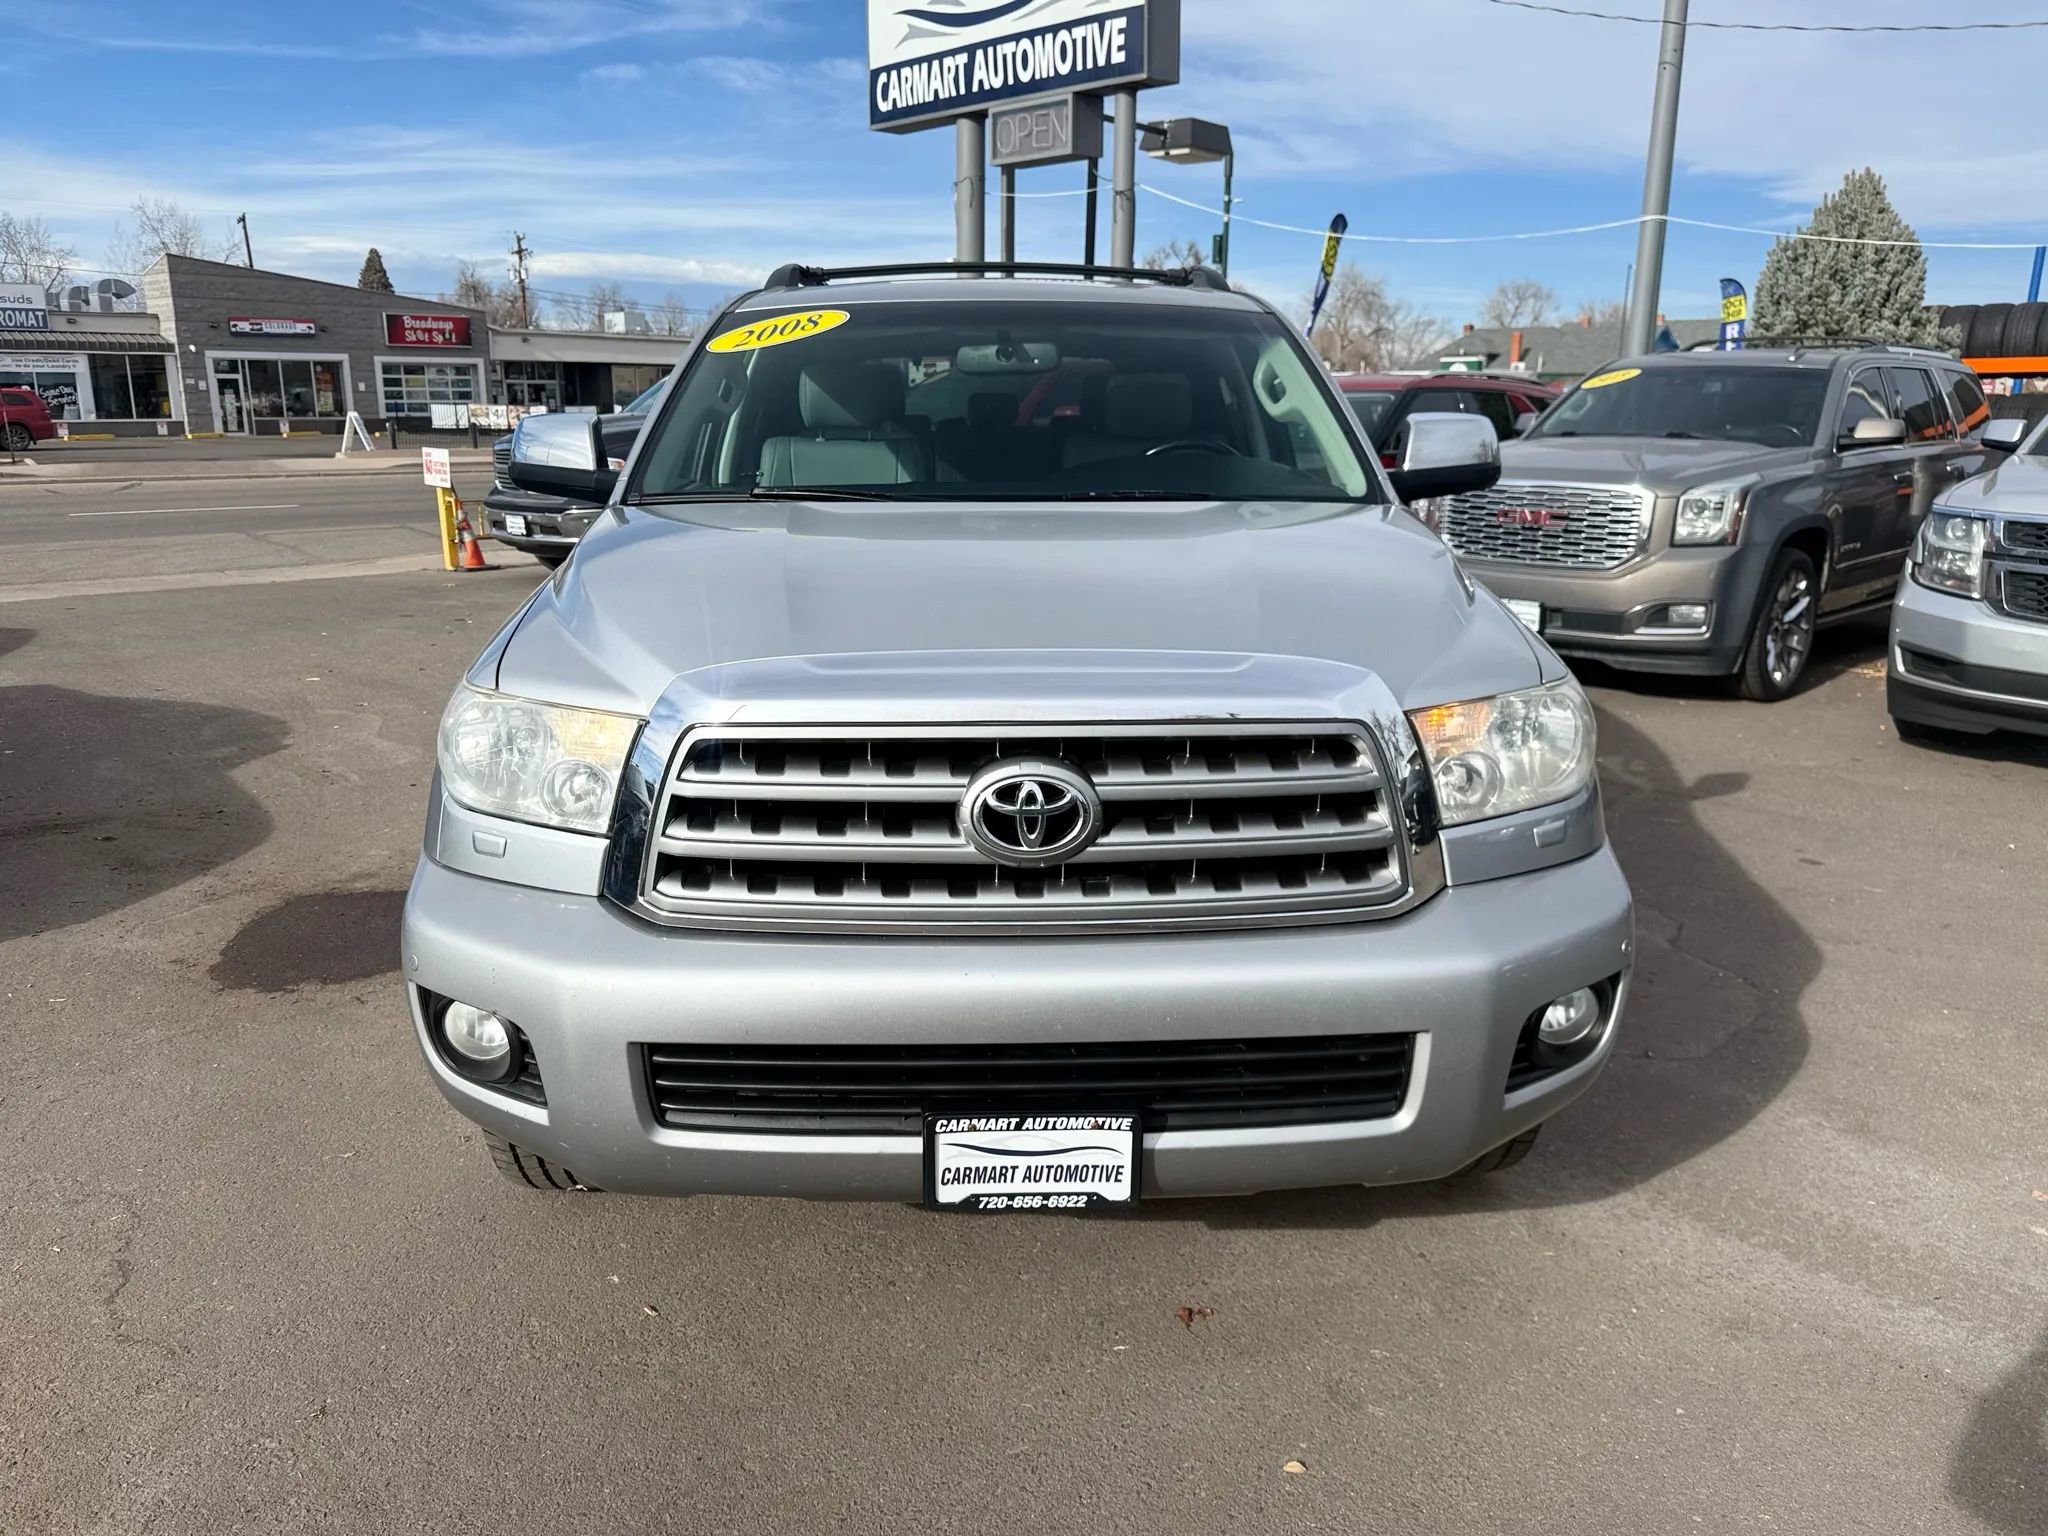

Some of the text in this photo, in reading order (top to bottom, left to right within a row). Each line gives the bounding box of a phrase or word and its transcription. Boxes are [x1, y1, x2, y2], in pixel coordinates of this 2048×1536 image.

[876, 16, 1128, 113] CARMART AUTOMOTIVE
[996, 111, 1069, 154] OPEN
[732, 314, 823, 348] 2008
[1497, 508, 1568, 528] GMC
[935, 1116, 1133, 1133] CARMART AUTOMOTIVE
[940, 1164, 1125, 1186] CARMART AUTOMOTIVE
[978, 1195, 1088, 1209] 720-656-6922
